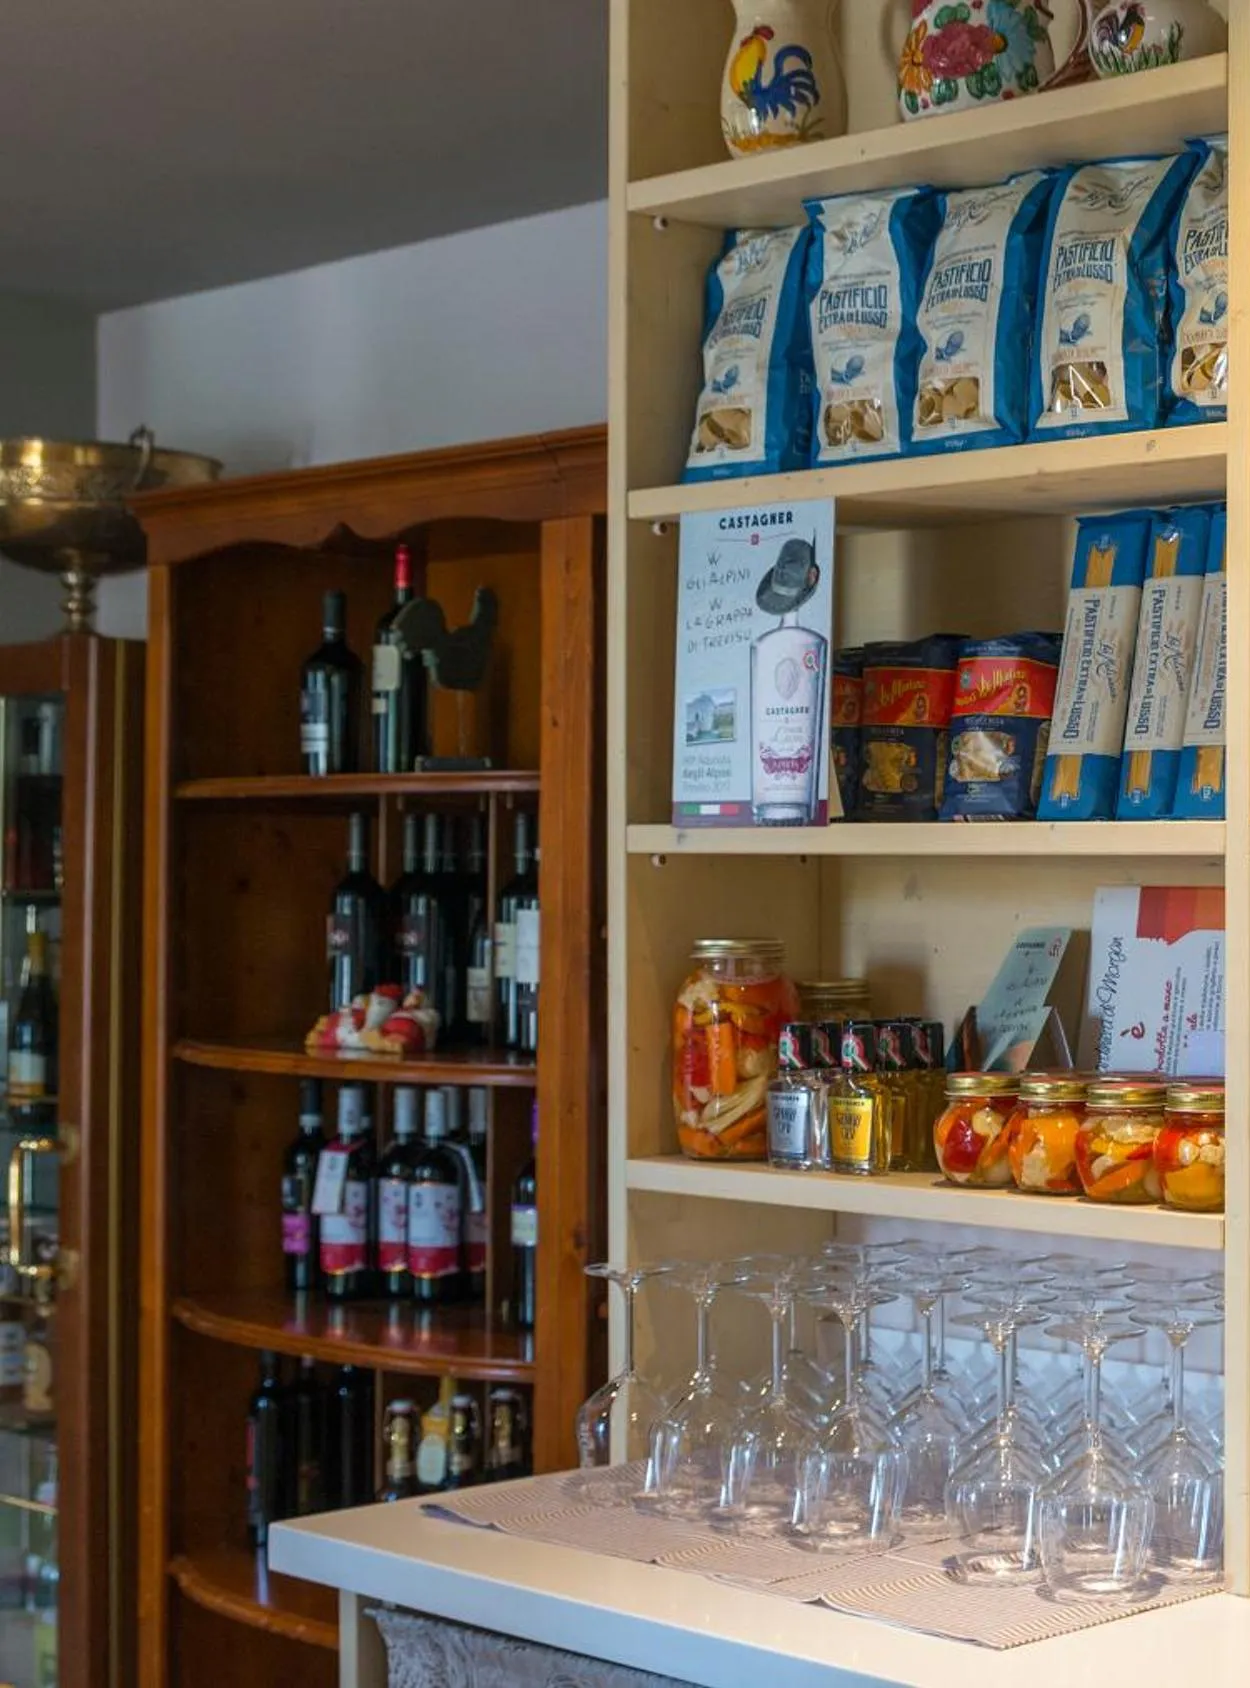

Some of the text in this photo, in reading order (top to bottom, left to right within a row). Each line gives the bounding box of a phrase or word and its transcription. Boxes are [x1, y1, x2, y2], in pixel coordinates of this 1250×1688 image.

[1054, 238, 1115, 271] PASTIFICIO
[928, 258, 992, 297] PASTIFICIO
[819, 285, 887, 314] PASTIFICIO
[853, 309, 888, 329] LUSSO
[719, 511, 794, 530] CASTAGNER
[1082, 599, 1100, 657] PASTIFICIO
[1150, 588, 1166, 650] PASTIFICIO
[1077, 660, 1090, 694] EXTRA
[1147, 652, 1159, 688] EXTRA
[1063, 701, 1086, 739] LUSSO
[1134, 695, 1155, 735] LUSSO
[1203, 689, 1225, 729] LUSSO
